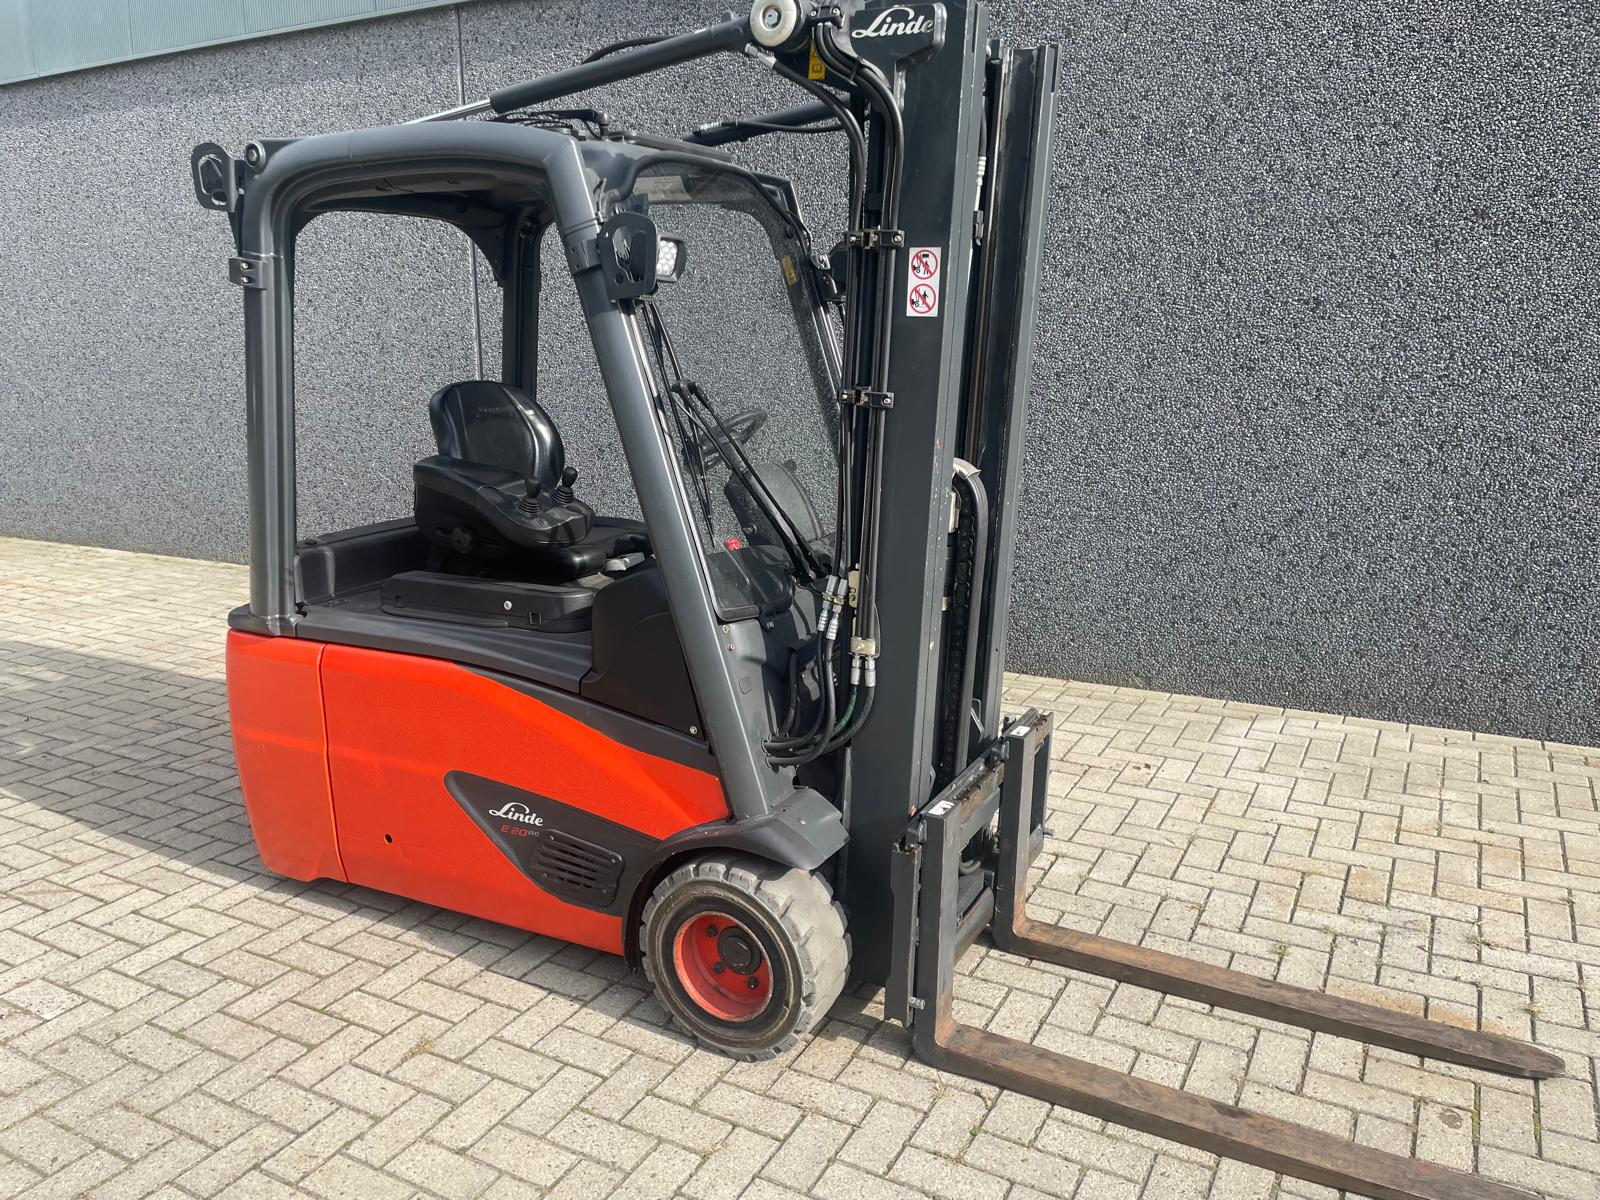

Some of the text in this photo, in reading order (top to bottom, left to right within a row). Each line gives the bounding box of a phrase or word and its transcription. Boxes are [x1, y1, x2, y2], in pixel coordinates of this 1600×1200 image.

[851, 6, 934, 38] Linde
[488, 802, 544, 826] Linde
[501, 824, 510, 833] E
